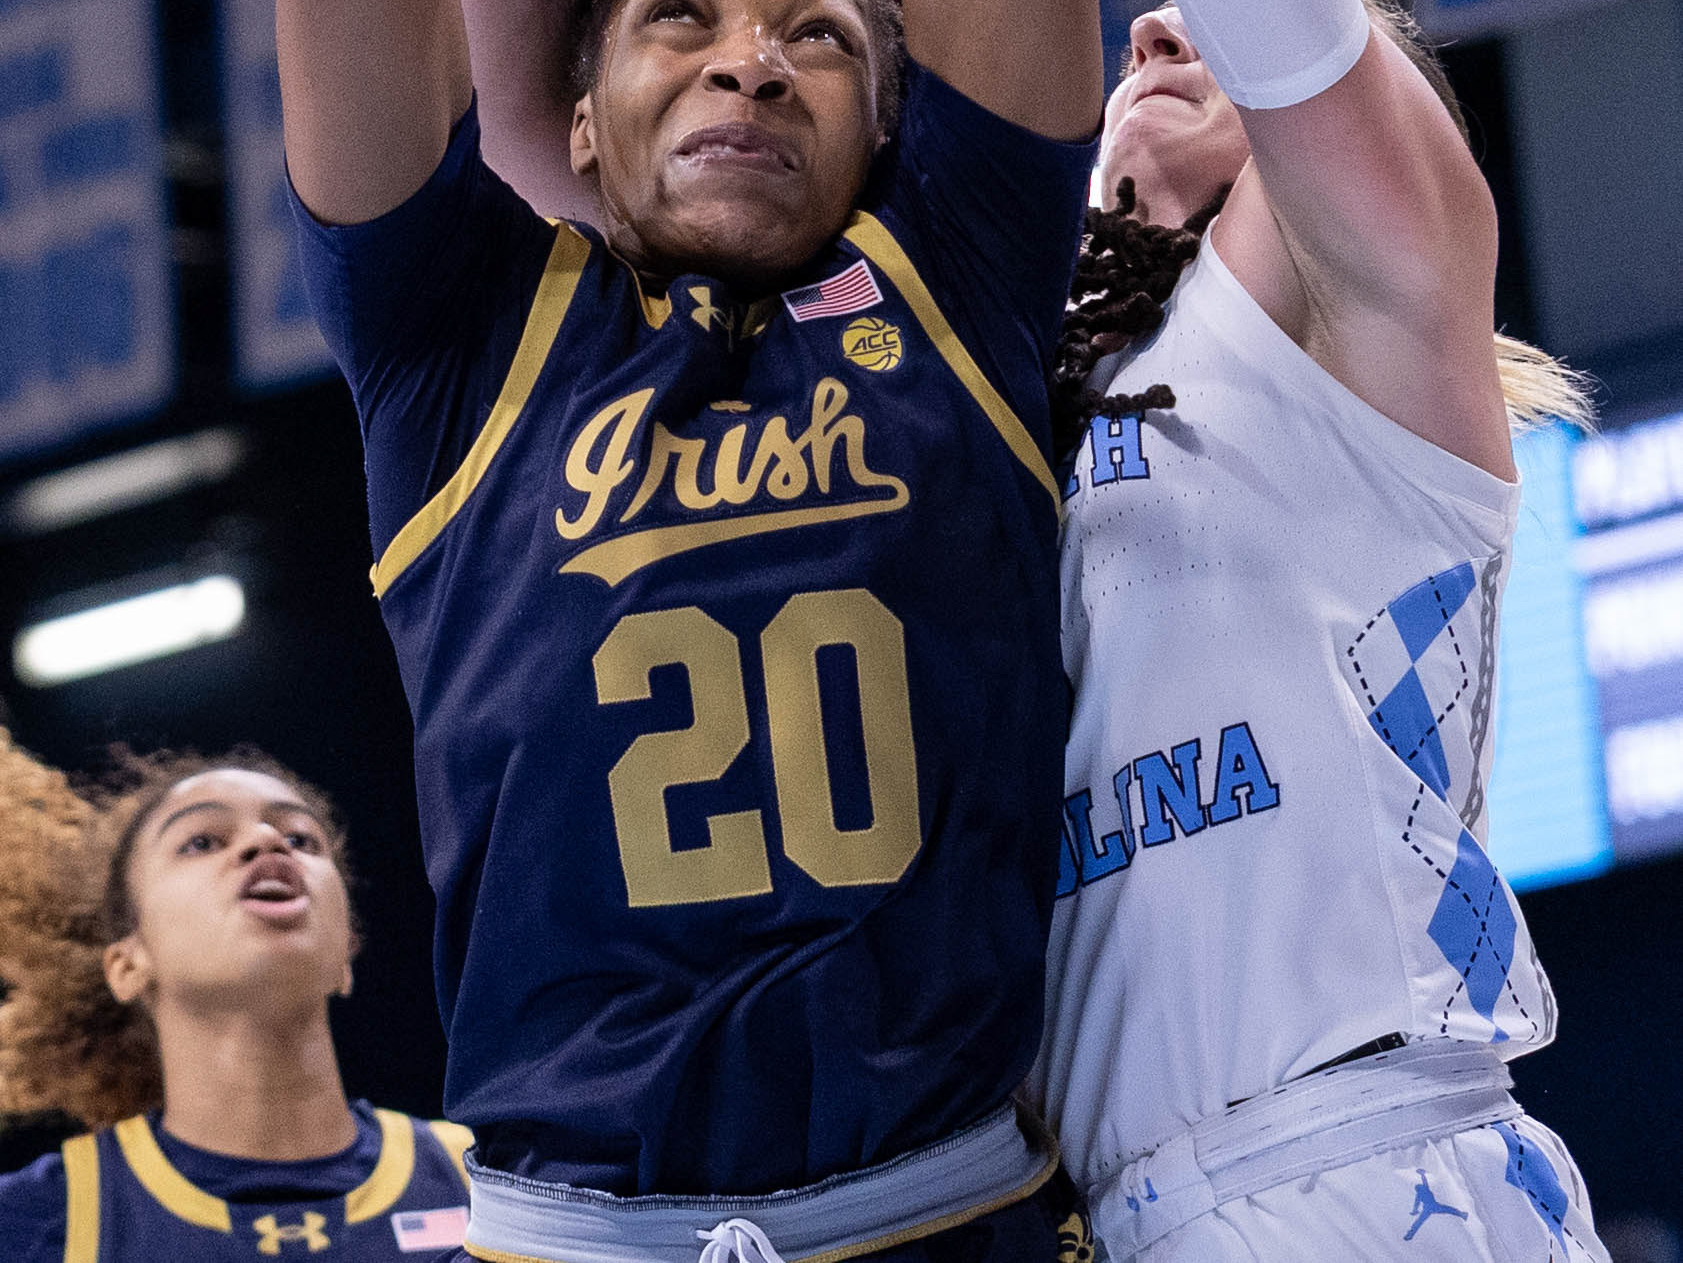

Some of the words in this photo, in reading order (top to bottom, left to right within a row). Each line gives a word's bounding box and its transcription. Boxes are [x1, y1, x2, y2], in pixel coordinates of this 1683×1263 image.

[850, 328, 899, 353] ACC
[555, 376, 910, 542] Irish
[592, 588, 922, 908] 20
